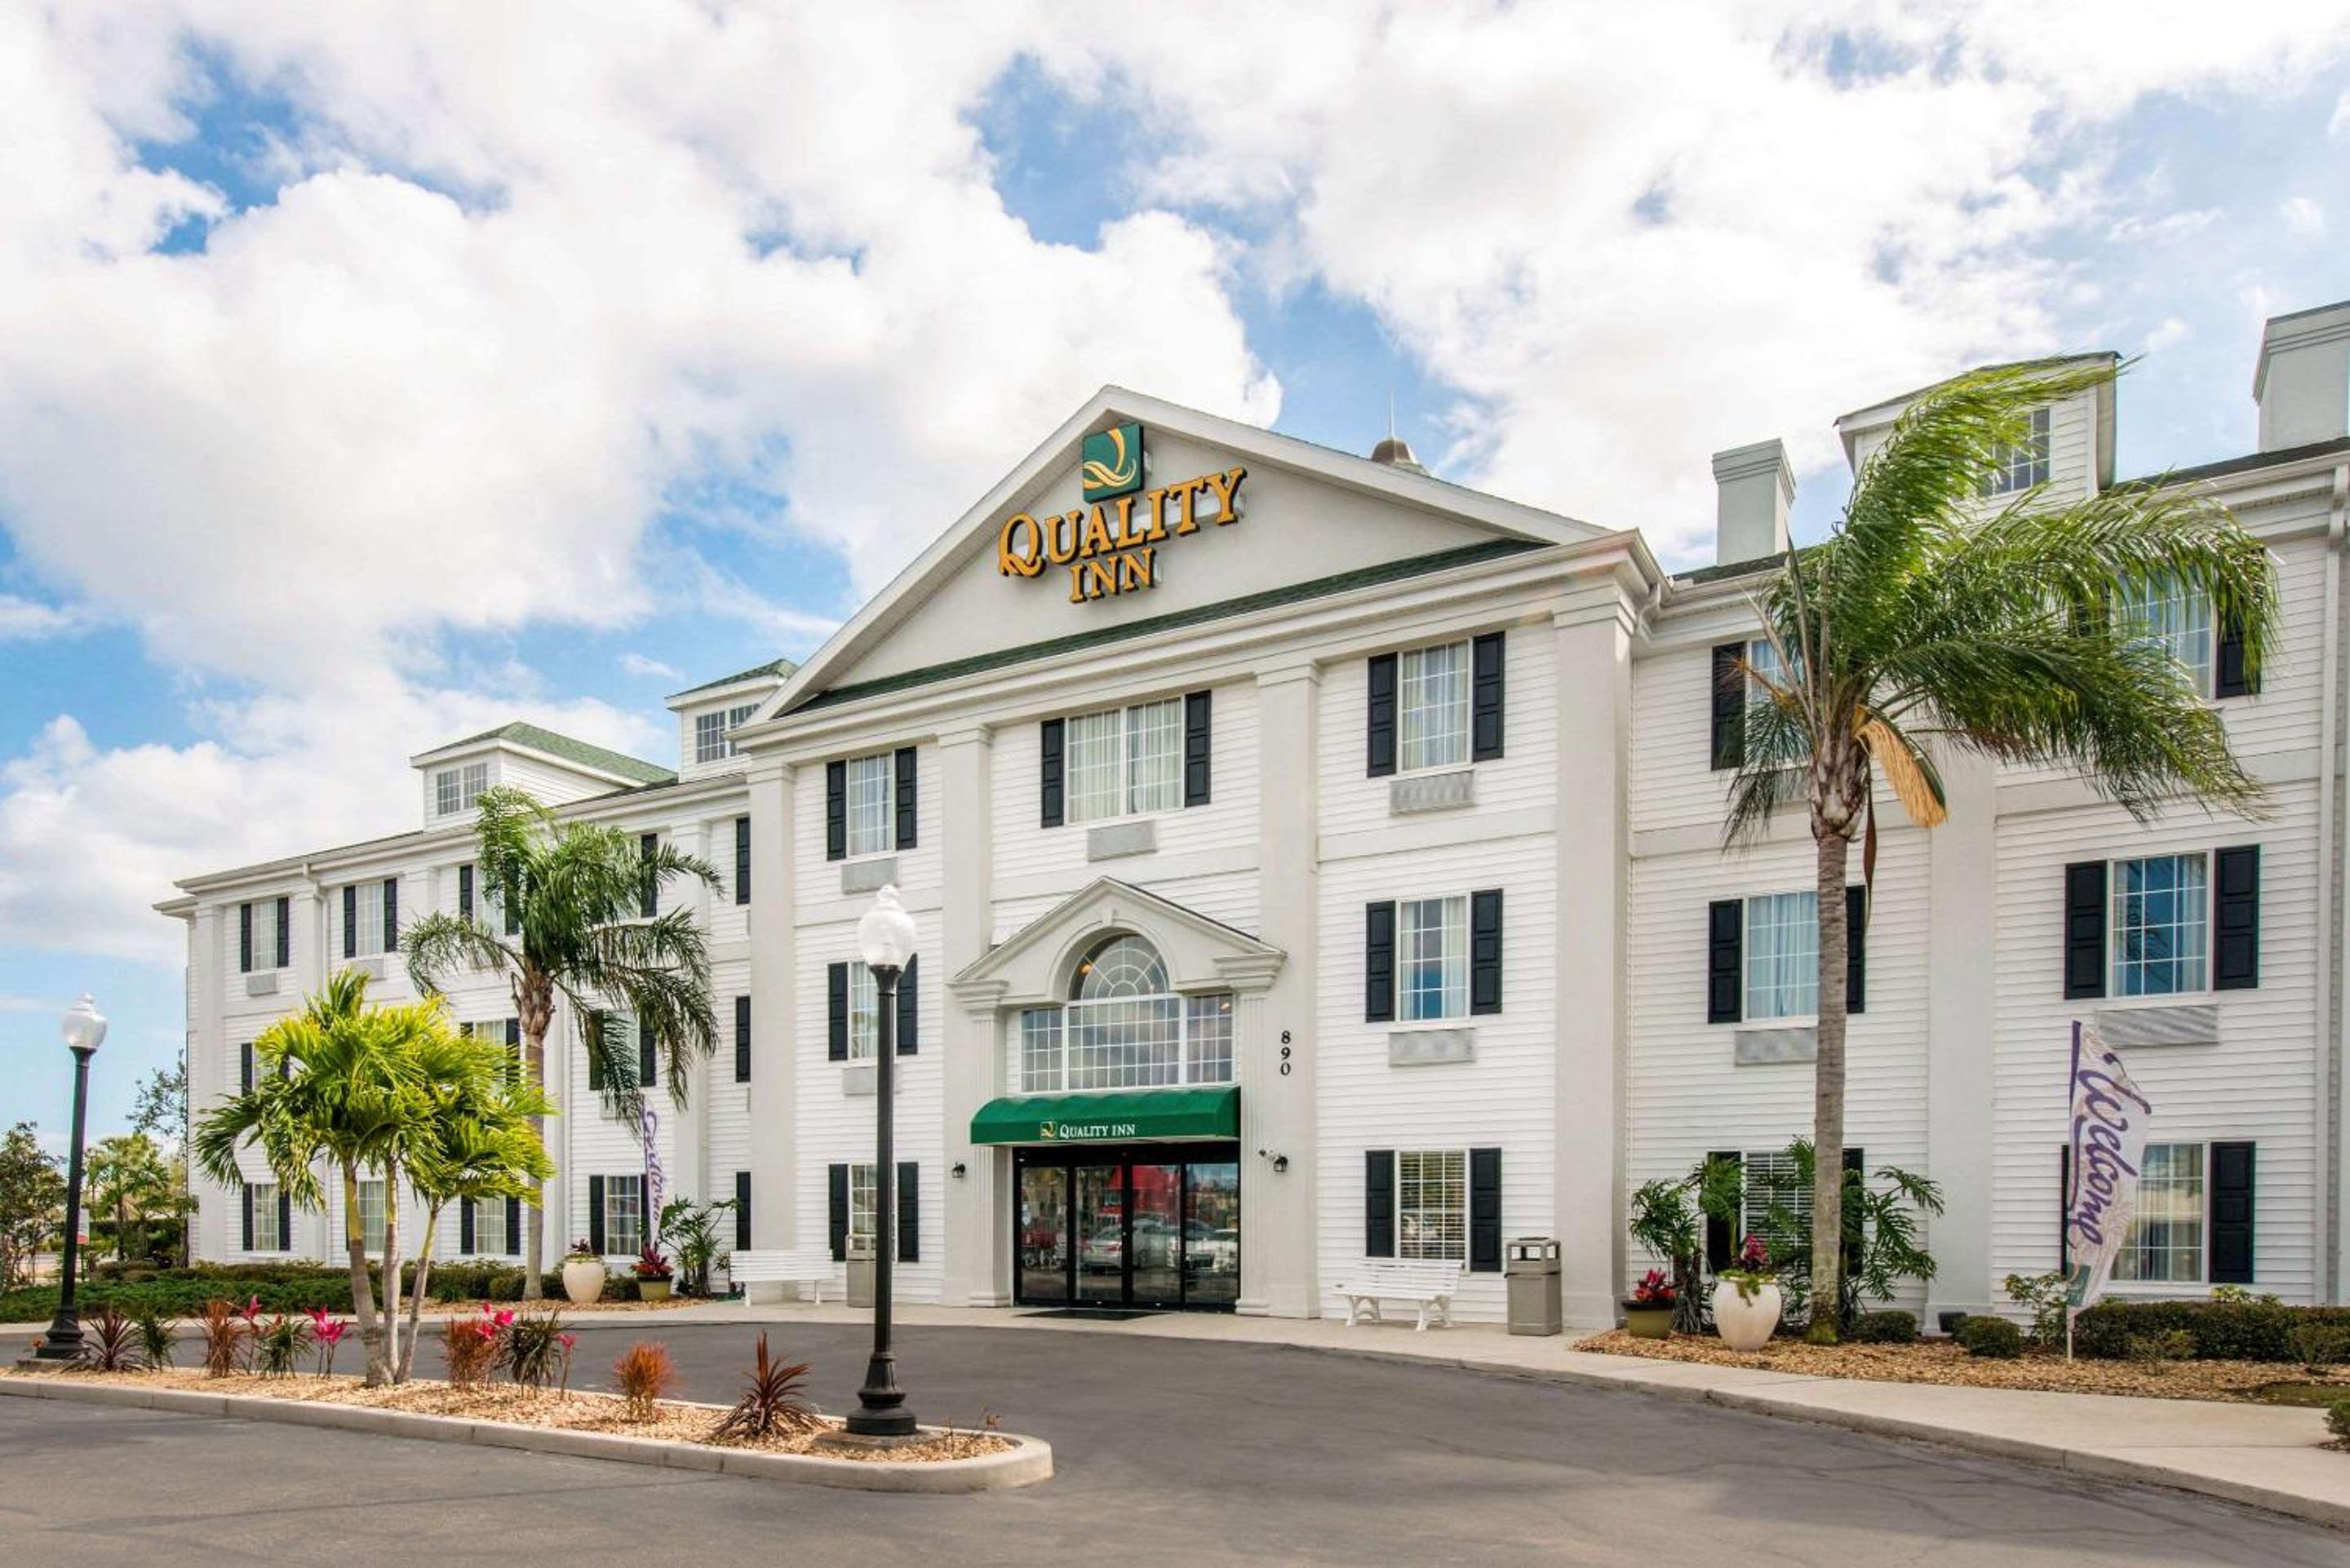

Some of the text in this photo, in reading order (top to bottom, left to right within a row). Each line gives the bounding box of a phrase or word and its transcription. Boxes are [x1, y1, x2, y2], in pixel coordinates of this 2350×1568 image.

[998, 465, 1248, 578] QUALITY
[1069, 547, 1156, 604] INN
[1280, 1030, 1291, 1076] 890
[1060, 1123, 1135, 1139] QUALITY INN
[2069, 1052, 2152, 1247] Welcome
